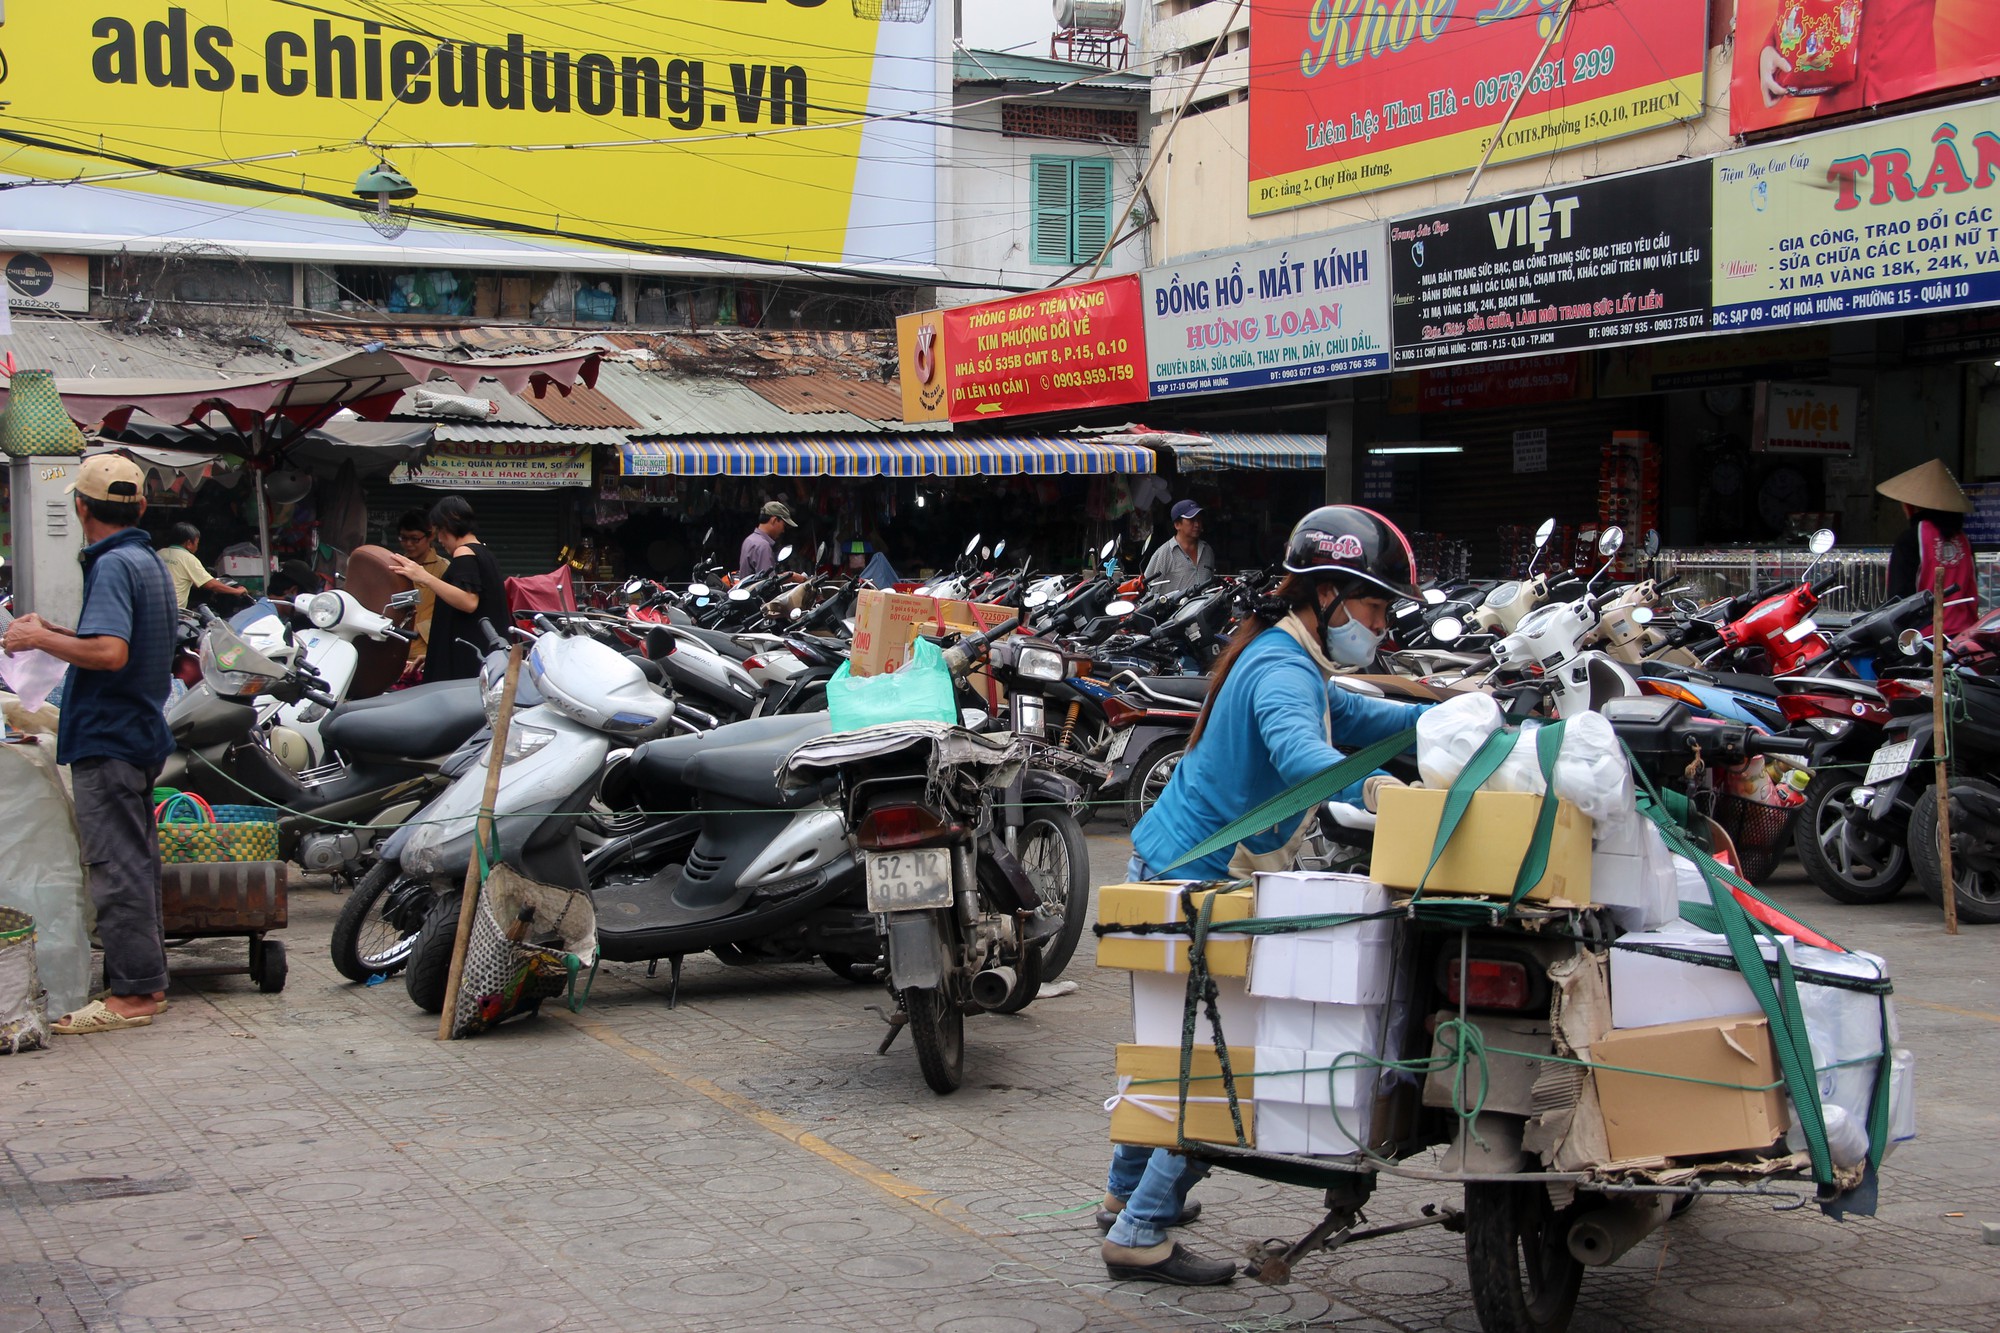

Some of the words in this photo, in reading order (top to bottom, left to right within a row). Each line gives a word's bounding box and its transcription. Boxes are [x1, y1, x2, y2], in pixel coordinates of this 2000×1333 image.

[92, 8, 808, 131] ads.chieuduong.vn
[1306, 119, 1347, 151] Liên
[1351, 109, 1379, 140] hệ:
[1383, 100, 1423, 131] Thu
[1428, 88, 1458, 120] Hà
[1474, 70, 1523, 108] 0973
[1529, 58, 1566, 94] 631
[1572, 45, 1615, 83] 299
[1632, 92, 1679, 116] TP.HCM
[1261, 187, 1278, 200] ĐC:
[1281, 180, 1301, 196] tầng
[1304, 179, 1312, 191] 2,
[1315, 174, 1334, 189] Chợ
[1361, 164, 1392, 178] Hưng,
[1769, 159, 1786, 172] Cao
[1489, 194, 1580, 253] VIỆT
[1779, 237, 1804, 251] GIA
[1810, 228, 1858, 248] CÔNG,
[1865, 221, 1910, 238] TRAO
[1917, 213, 1948, 231] ĐỔI
[1955, 206, 1992, 225] CÁC
[1422, 273, 1436, 285] MUA
[1438, 269, 1452, 283] BÁN
[1454, 267, 1476, 280] TRANG
[1478, 262, 1492, 277] SỨC
[1494, 262, 1510, 275] BẠC,
[1513, 259, 1524, 271] GIA
[1527, 254, 1546, 269] CÔNG
[1548, 251, 1573, 266] TRANG
[1575, 246, 1590, 261] SỨC
[1593, 246, 1609, 259] BẠC
[1611, 242, 1632, 256] THEO
[1634, 237, 1650, 252] YÊU
[1653, 232, 1670, 249] CẦU
[1779, 252, 1810, 271] SỬA
[1816, 247, 1860, 265] CHỮA
[1867, 240, 1900, 258] CÁC
[1907, 235, 1947, 253] LOẠI
[1955, 228, 1981, 246] NỮ
[1156, 273, 1209, 316] ĐỒNG
[1216, 262, 1243, 306] HỒ
[1259, 252, 1304, 299] MẮT
[1314, 248, 1368, 289] KÍNH
[1422, 288, 1440, 302] ĐÁNH
[1443, 285, 1461, 299] BÓNG
[1463, 285, 1468, 296] &
[1470, 280, 1483, 294] MÀI
[1485, 278, 1499, 292] CÁC
[1501, 277, 1517, 291] LOẠI
[1534, 271, 1555, 286] CHẠM
[1619, 256, 1641, 272] TRÊN
[1643, 256, 1659, 270] MỌI
[1680, 247, 1699, 264] LIỆU
[1780, 277, 1793, 290] XI
[1801, 273, 1824, 288] MẠ
[1830, 266, 1874, 283] VÀNG
[1882, 261, 1920, 276] 18K,
[1927, 254, 1968, 271] 24K,
[970, 310, 1005, 328] THÔNG
[1009, 305, 1034, 321] BÁO:
[1039, 298, 1067, 315] TIỆM
[1423, 308, 1429, 319] XI
[1443, 302, 1461, 316] VÀNG
[1464, 301, 1478, 314] 18K,
[1481, 298, 1496, 311] 24K,
[1499, 295, 1517, 308] BẠCH
[1520, 293, 1540, 305] KIM...
[1558, 303, 1591, 321] TRANG
[1713, 312, 1727, 325] ĐC:
[1730, 309, 1748, 325] SẠP
[1751, 307, 1762, 320] 09
[1771, 302, 1791, 319] CHỢ
[1794, 301, 1813, 316] HOÀ
[1817, 297, 1843, 313] HƯNG
[1853, 291, 1894, 309] PHƯỜNG
[1898, 289, 1911, 303] 15
[1921, 284, 1951, 303] QUẬN
[1955, 282, 1969, 297] 10
[978, 334, 998, 352] KIM
[1001, 325, 1047, 347] PHƯỢNG
[1074, 311, 1091, 336] VỀ
[1186, 317, 1260, 348] HƯNG
[1264, 303, 1342, 339] LOAN
[1602, 325, 1618, 337] 0905
[1620, 323, 1633, 335] 397
[1635, 322, 1648, 333] 935
[1654, 319, 1672, 331] 0903
[1674, 317, 1688, 328] 735
[1690, 315, 1703, 326] 074
[955, 358, 975, 376] NHÀ
[978, 354, 993, 373] SỐ
[996, 355, 1021, 370] 535B
[1025, 350, 1048, 366] CMT
[1052, 349, 1061, 364] 8,
[1064, 345, 1093, 360] P.15,
[1097, 339, 1127, 356] Q.10
[1157, 358, 1187, 377] CHUYÊN
[1190, 356, 1209, 373] BÁN,
[1211, 352, 1227, 371] SỬA
[1257, 349, 1279, 364] THAY
[1283, 346, 1300, 362] PIN,
[1303, 340, 1323, 359] DÂY,
[1327, 336, 1348, 355] CHÙI
[1417, 349, 1423, 358] 11
[1471, 341, 1487, 351] CMT8
[1493, 338, 1506, 349] P.15
[1511, 336, 1525, 348] Q.10
[1530, 333, 1554, 344] TP.HCM
[967, 383, 986, 398] LÊN
[988, 383, 1000, 396] 10
[1002, 377, 1023, 394] CĂN
[1053, 364, 1133, 388] 0903.959.759
[1282, 369, 1298, 378] 0903
[1299, 367, 1311, 376] 677
[1313, 365, 1325, 374] 629
[1331, 362, 1347, 372] 0903
[1349, 360, 1362, 369] 766
[1364, 358, 1376, 368] 356
[1170, 382, 1185, 391] 17-19
[41, 466, 66, 481] OPT1
[559, 468, 578, 478] TAY
[1319, 536, 1363, 556] moto
[856, 633, 871, 651] OMO
[877, 853, 939, 880] 52-M2
